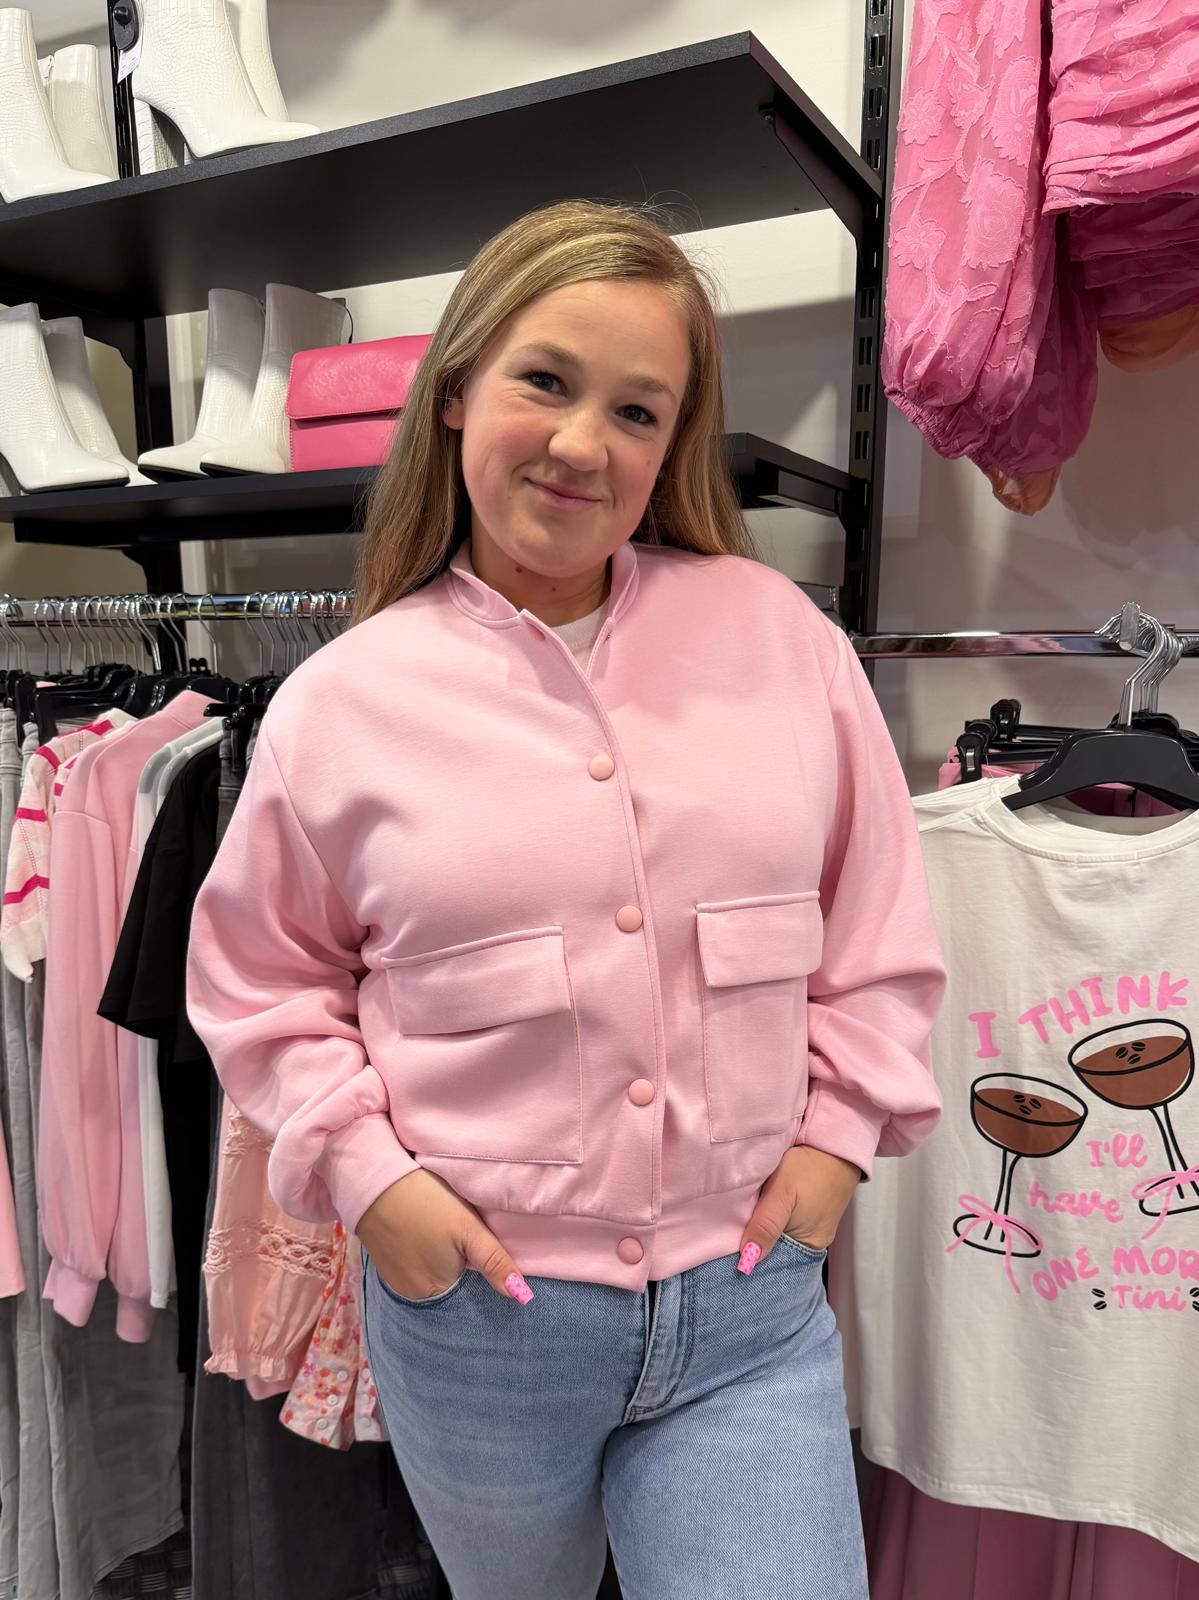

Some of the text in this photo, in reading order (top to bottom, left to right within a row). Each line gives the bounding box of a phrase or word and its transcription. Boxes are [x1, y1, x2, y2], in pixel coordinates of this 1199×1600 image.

[967, 969, 1190, 1059] I THINK
[1084, 1132, 1149, 1169] I'll
[1027, 1183, 1125, 1225] have
[1031, 1247, 1101, 1302] ONE
[1110, 1284, 1187, 1312] Tini
